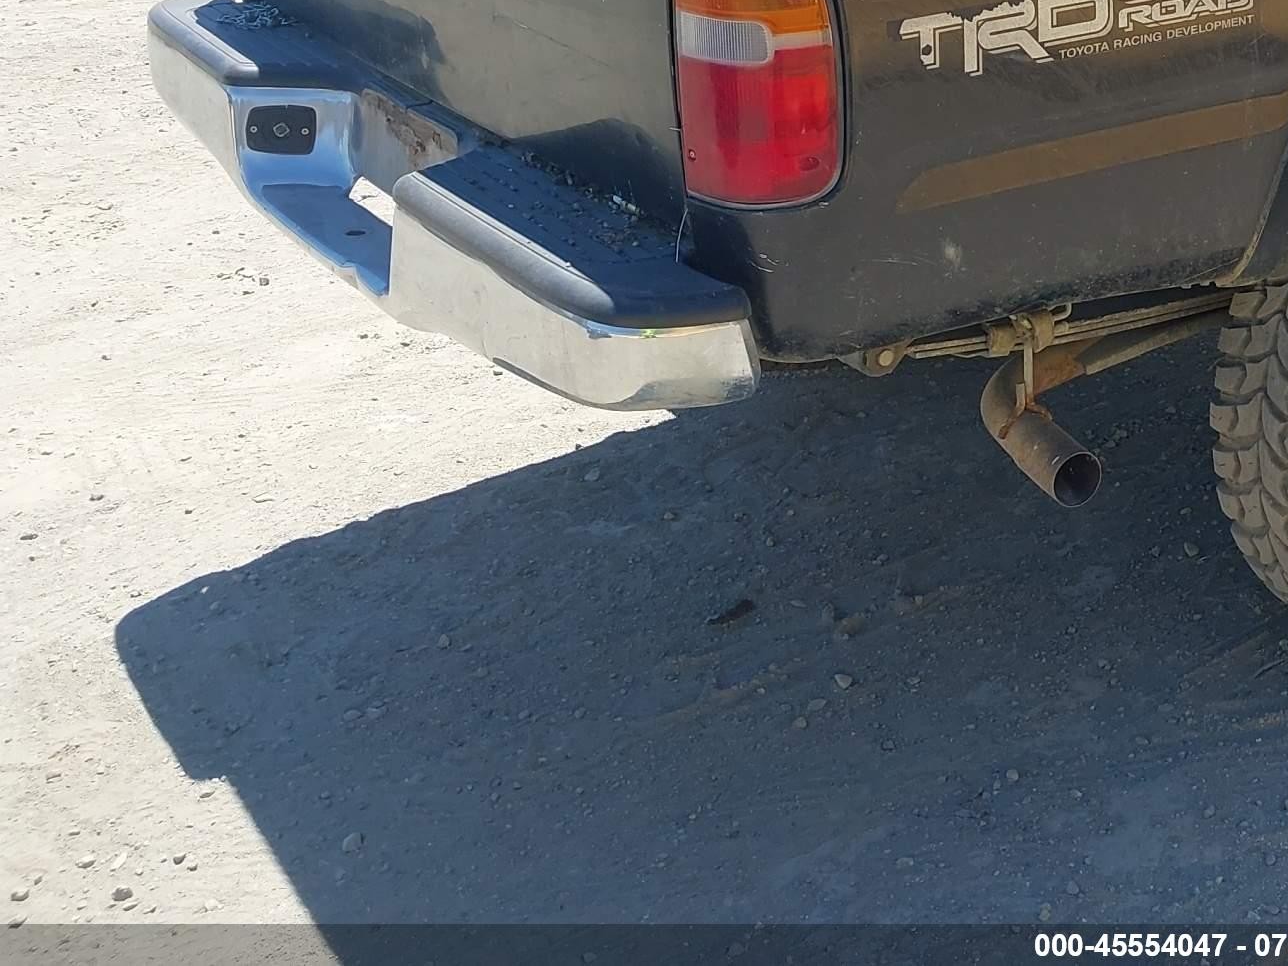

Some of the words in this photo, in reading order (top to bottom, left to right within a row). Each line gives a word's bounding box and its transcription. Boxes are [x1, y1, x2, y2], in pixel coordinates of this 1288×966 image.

[1058, 41, 1110, 59] TOYOTA
[1113, 30, 1163, 49] RACING
[1166, 14, 1255, 40] DEVELOPMENT
